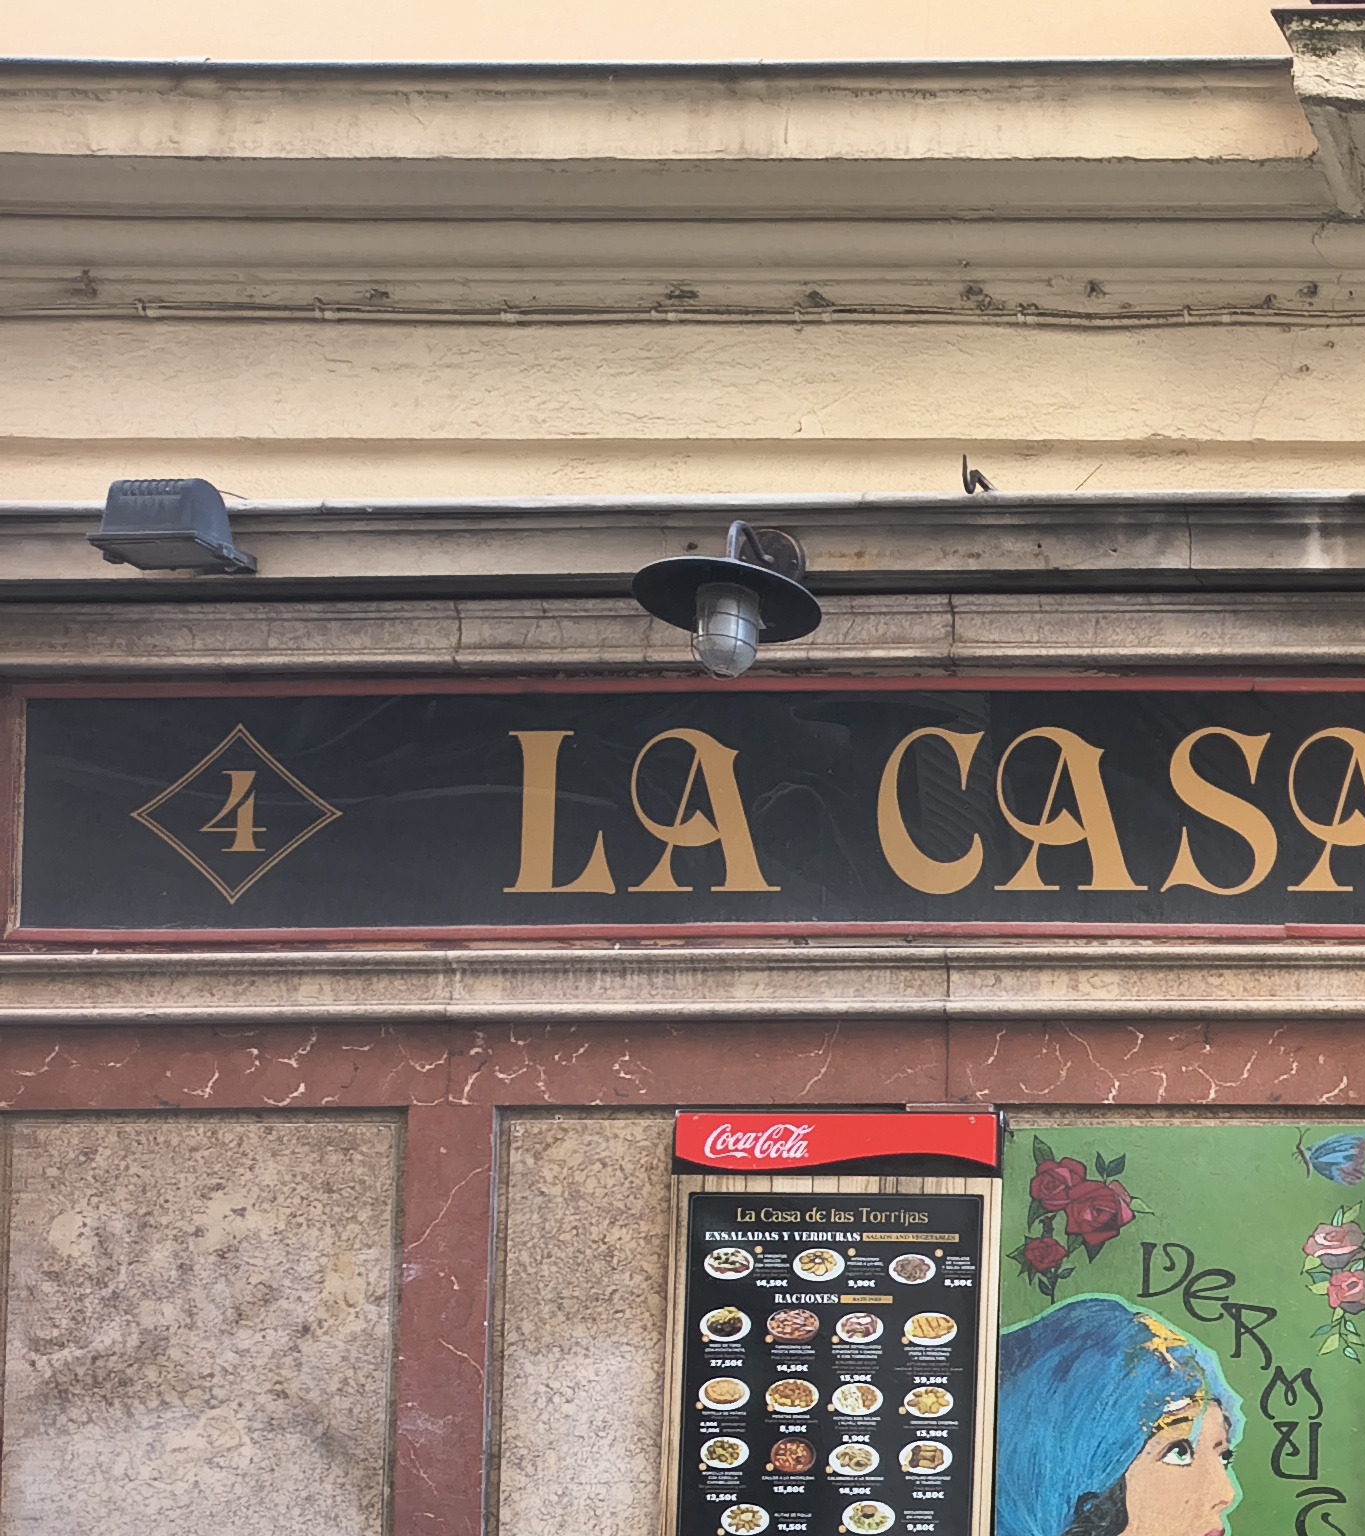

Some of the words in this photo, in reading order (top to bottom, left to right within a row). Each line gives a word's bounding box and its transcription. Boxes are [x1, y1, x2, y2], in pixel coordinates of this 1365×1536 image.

[200, 771, 267, 853] 4
[503, 726, 781, 895] LA
[704, 1124, 815, 1158] Coca-Cola
[736, 1207, 756, 1222] La
[761, 1207, 801, 1222] Casa
[806, 1206, 827, 1223] de
[831, 1208, 855, 1223] las
[859, 1207, 929, 1227] Torrijas
[705, 1231, 779, 1241] ENSALADAS
[782, 1231, 791, 1241] Y
[793, 1231, 861, 1242] VERDURAS
[774, 1294, 839, 1304] RACIONES
